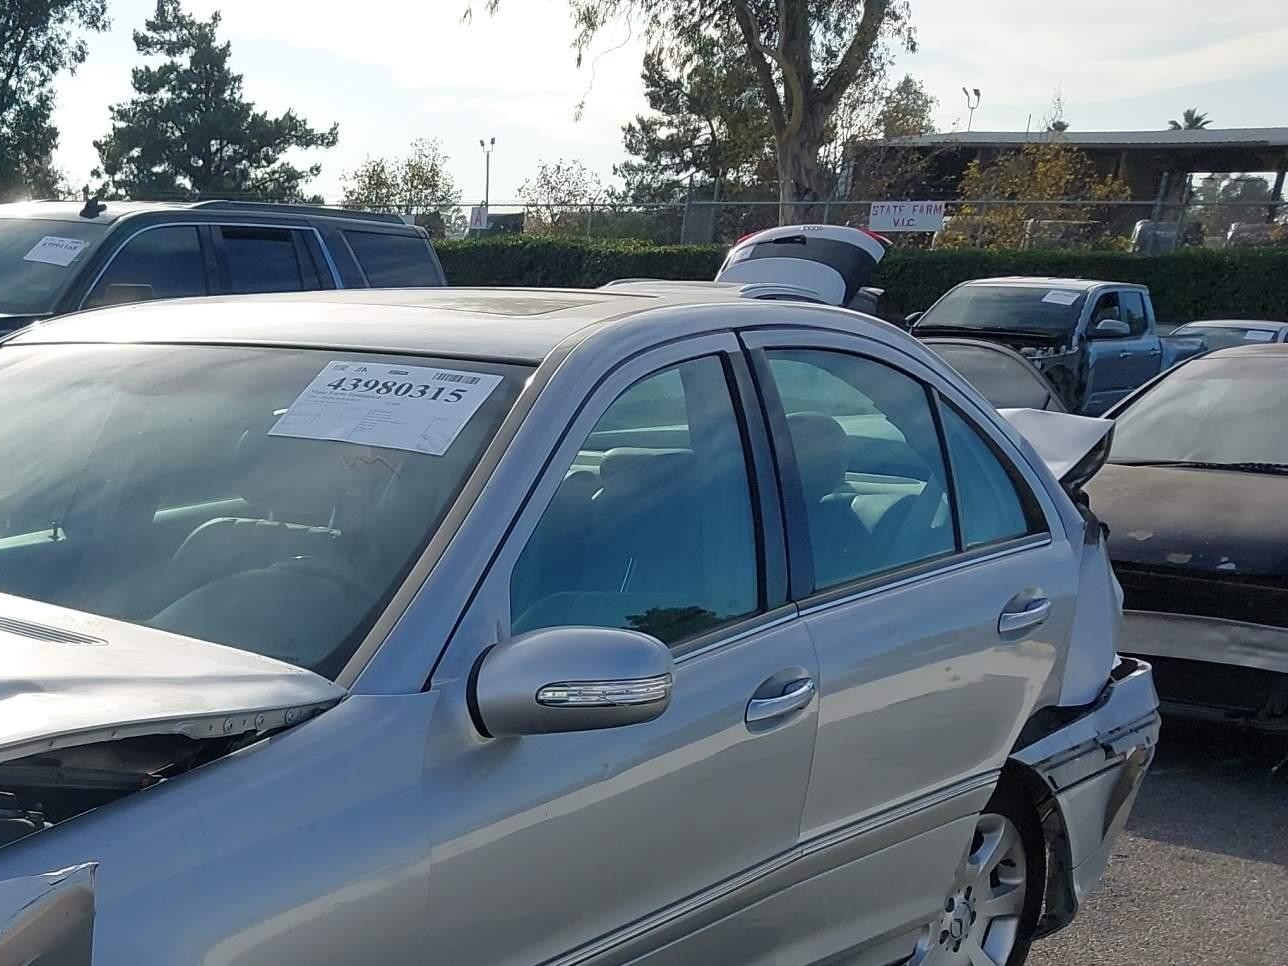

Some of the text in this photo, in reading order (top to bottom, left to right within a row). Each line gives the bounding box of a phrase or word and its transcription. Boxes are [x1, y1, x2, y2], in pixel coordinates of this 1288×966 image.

[872, 204, 943, 216] STATE FARM
[327, 376, 468, 403] 43980315
